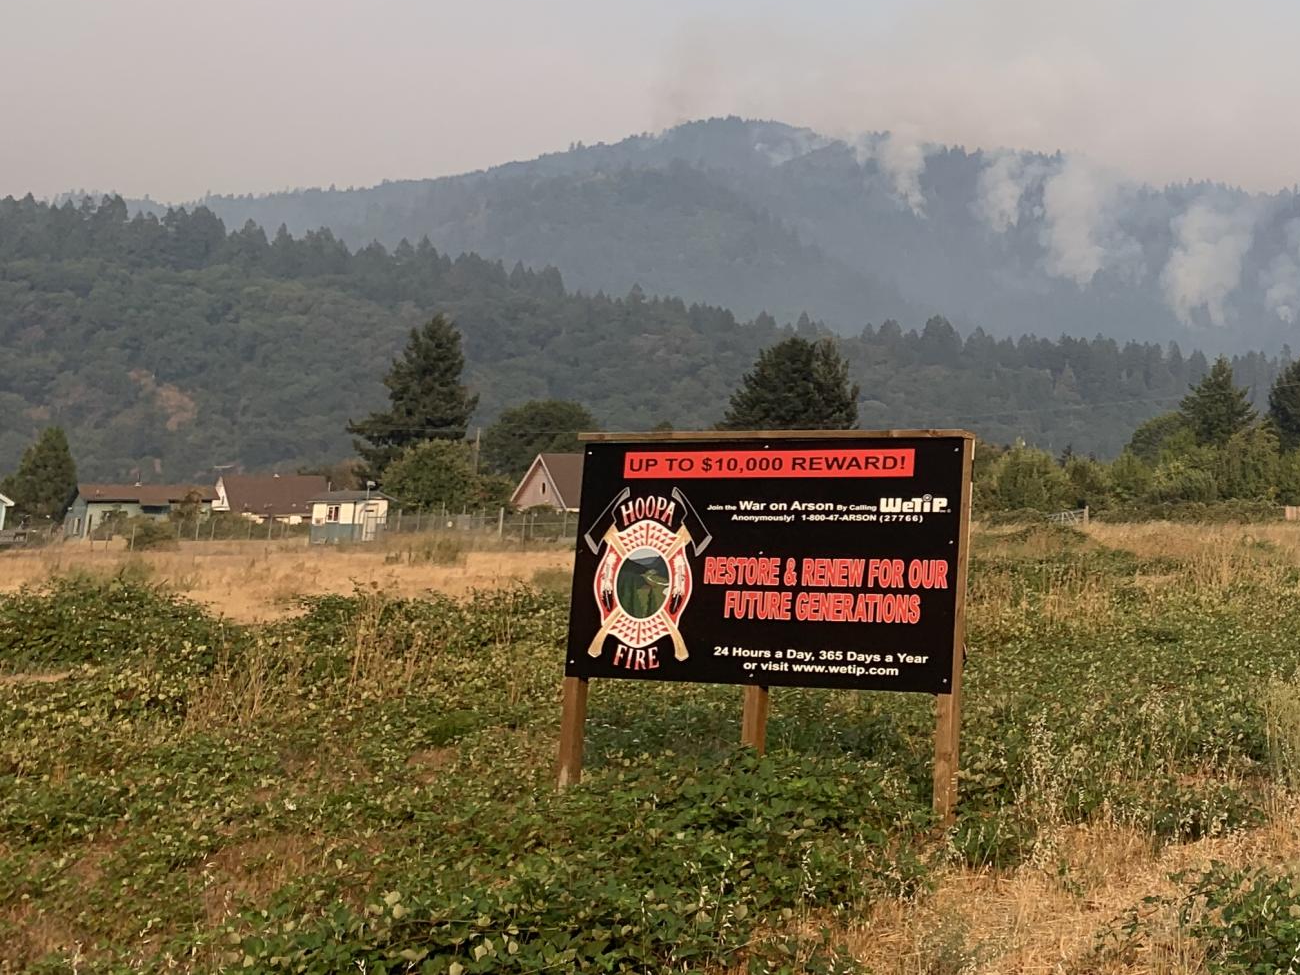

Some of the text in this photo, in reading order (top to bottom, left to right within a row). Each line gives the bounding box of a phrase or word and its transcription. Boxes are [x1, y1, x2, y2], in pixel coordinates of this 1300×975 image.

[629, 456, 907, 473] UP TO $10,000 REWARD!
[620, 495, 676, 527] HOOPA
[739, 500, 767, 511] War
[769, 502, 788, 511] on
[790, 500, 834, 511] Arson
[731, 514, 923, 523] Anonymously! 1-800-47-ARSON (27766)
[703, 557, 949, 589] RESTORE & RENEW FOR OUR
[723, 590, 921, 624] FUTURE GENERATIONS
[613, 644, 660, 670] FIRE
[714, 647, 729, 656] 24
[732, 648, 771, 657] Hours
[775, 650, 783, 658] a
[786, 649, 815, 660] Day,
[819, 651, 843, 660] 365
[847, 652, 881, 663] Days
[896, 653, 929, 663] Year
[743, 661, 899, 676] or visit www.wetip.com
